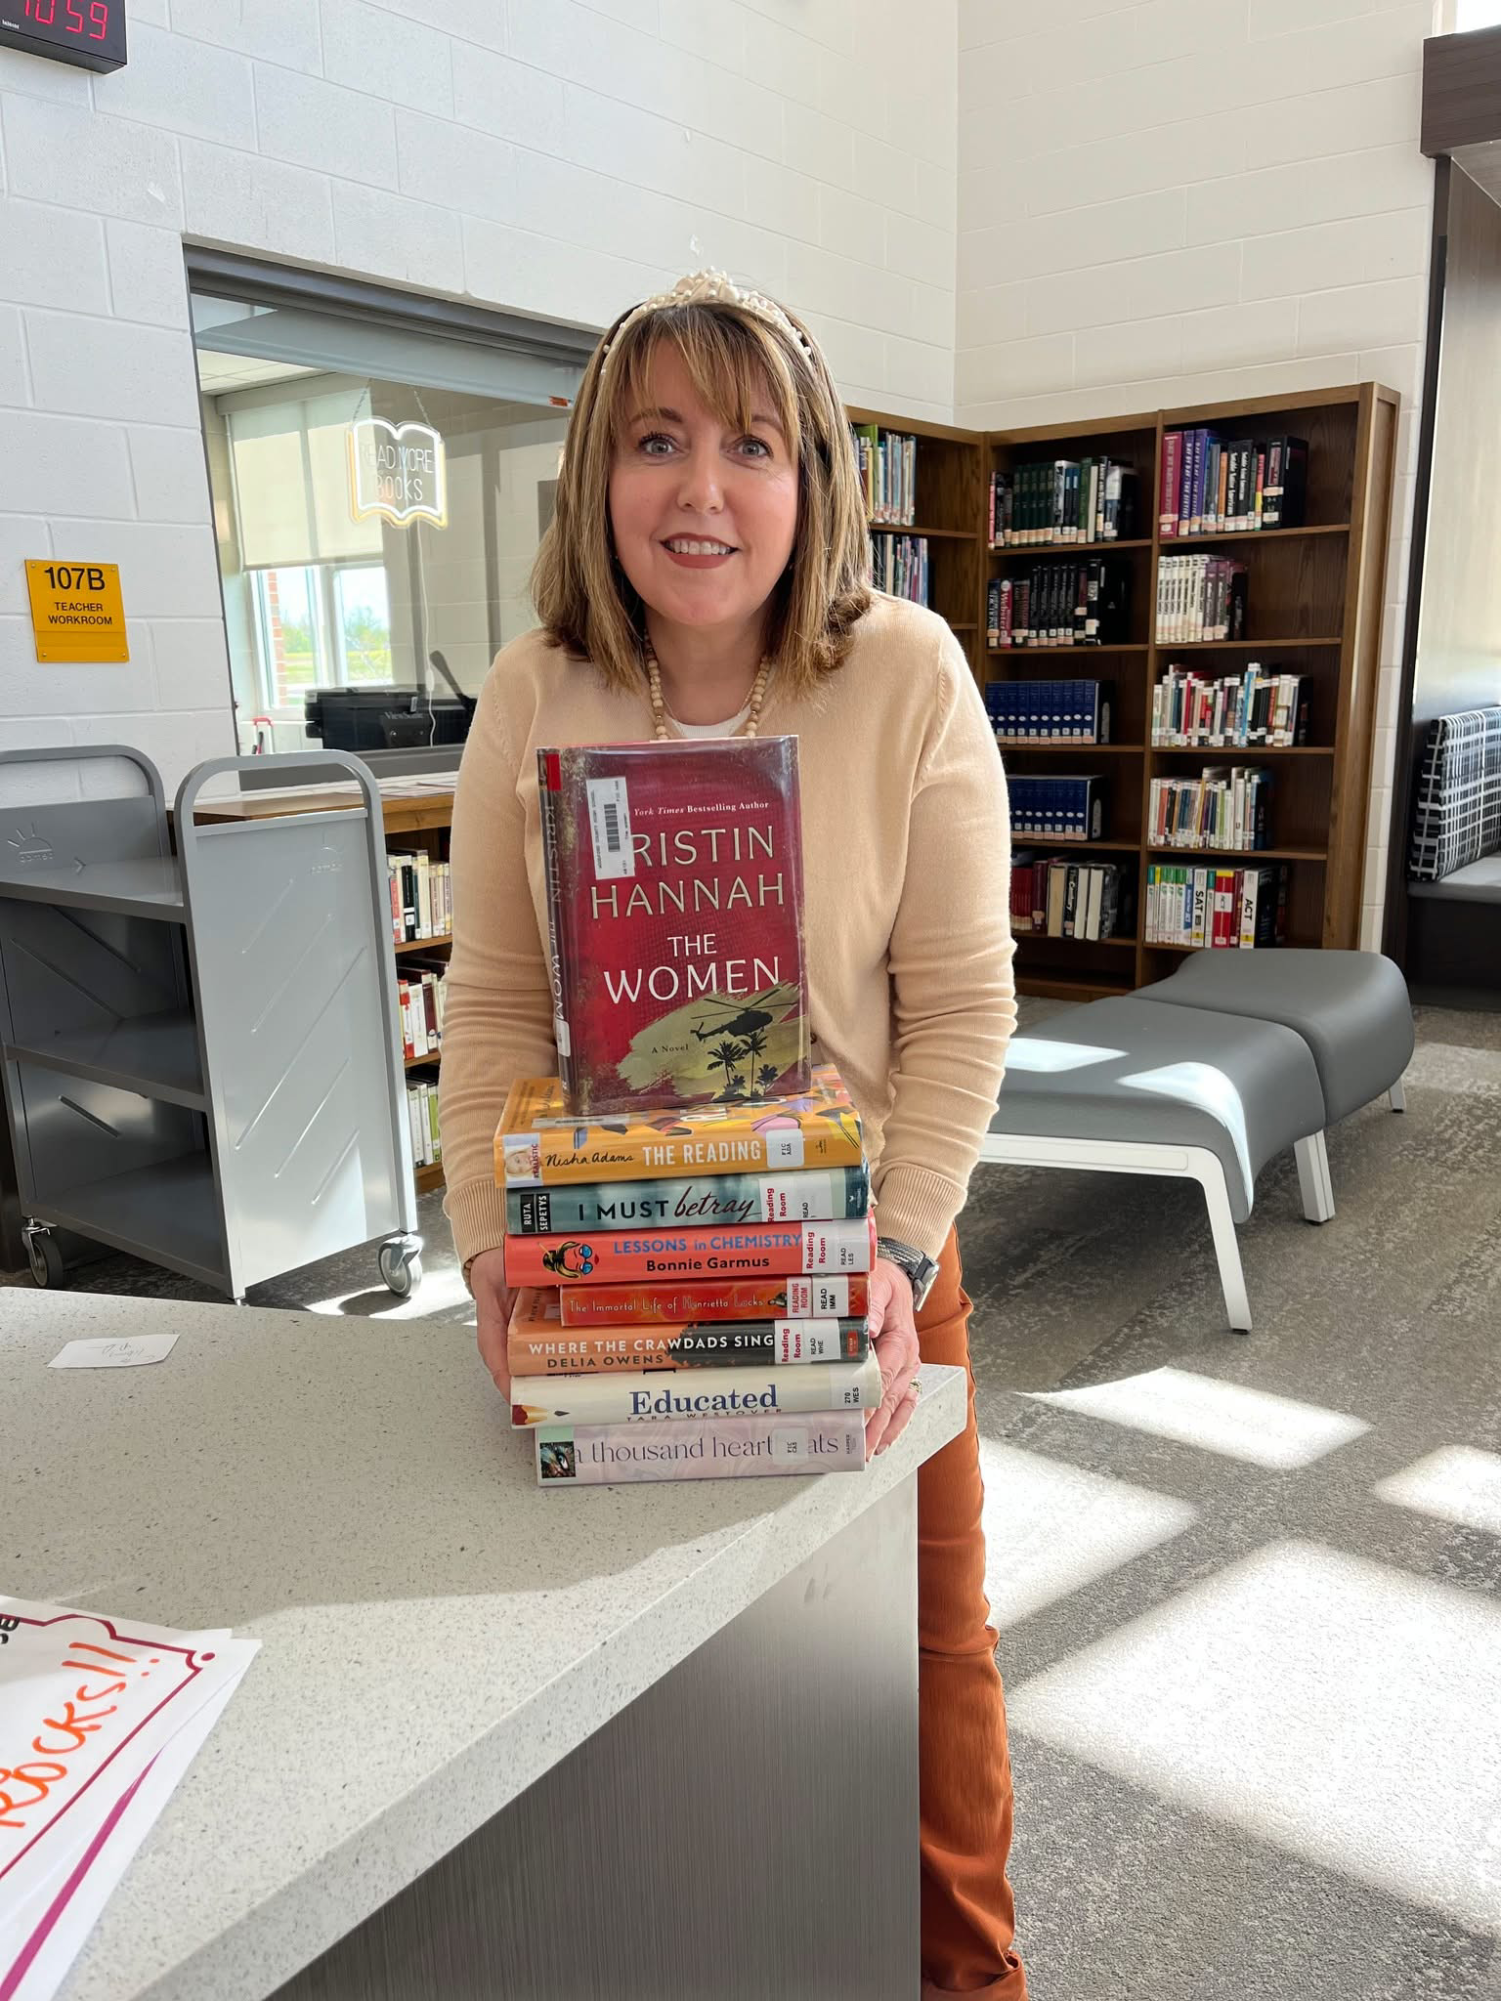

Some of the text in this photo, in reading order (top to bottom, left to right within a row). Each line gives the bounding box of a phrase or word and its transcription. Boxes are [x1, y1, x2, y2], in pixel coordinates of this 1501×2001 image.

[376, 475, 423, 501] BOOKS
[45, 566, 105, 591] 107B
[54, 601, 103, 612] TEACHER
[48, 614, 112, 625] WORKROOM
[634, 801, 769, 816] York Times Bestselling Author
[545, 806, 561, 903] KRISTIN
[631, 825, 774, 867] RISTIN
[590, 873, 784, 920] HANNAH
[1195, 891, 1204, 912] SAT
[1244, 899, 1253, 921] ACT
[667, 933, 717, 957] THE
[551, 955, 565, 1020] WOM
[603, 956, 780, 1005] WOMEN
[662, 1044, 689, 1053] Novel
[545, 1151, 635, 1167] Nisha Adams
[642, 1140, 762, 1167] THE READING
[523, 1203, 533, 1225] RUTA
[538, 1195, 548, 1231] SEPETYS
[578, 1185, 761, 1222] I MUST betray
[766, 1188, 775, 1222] Reading
[779, 1192, 787, 1217] Room
[613, 1234, 802, 1254] LESSONS in CHEMISTRY
[806, 1231, 815, 1269] Reading
[818, 1237, 826, 1264] Room
[647, 1257, 770, 1272] Bonnie Garmus
[570, 1300, 587, 1312] The
[592, 1299, 637, 1312] Immortal
[642, 1297, 662, 1313] Life
[667, 1297, 678, 1313] of
[791, 1283, 799, 1314] READING
[800, 1287, 808, 1309] ROOM
[820, 1288, 828, 1310] READ
[529, 1334, 774, 1355] WHERE THE CRAWDADS SING
[781, 1328, 790, 1363] Reading
[794, 1333, 802, 1358] Room
[547, 1354, 664, 1369] DELIA OWENS
[629, 1384, 779, 1415] Educated
[592, 1437, 704, 1464] thousand
